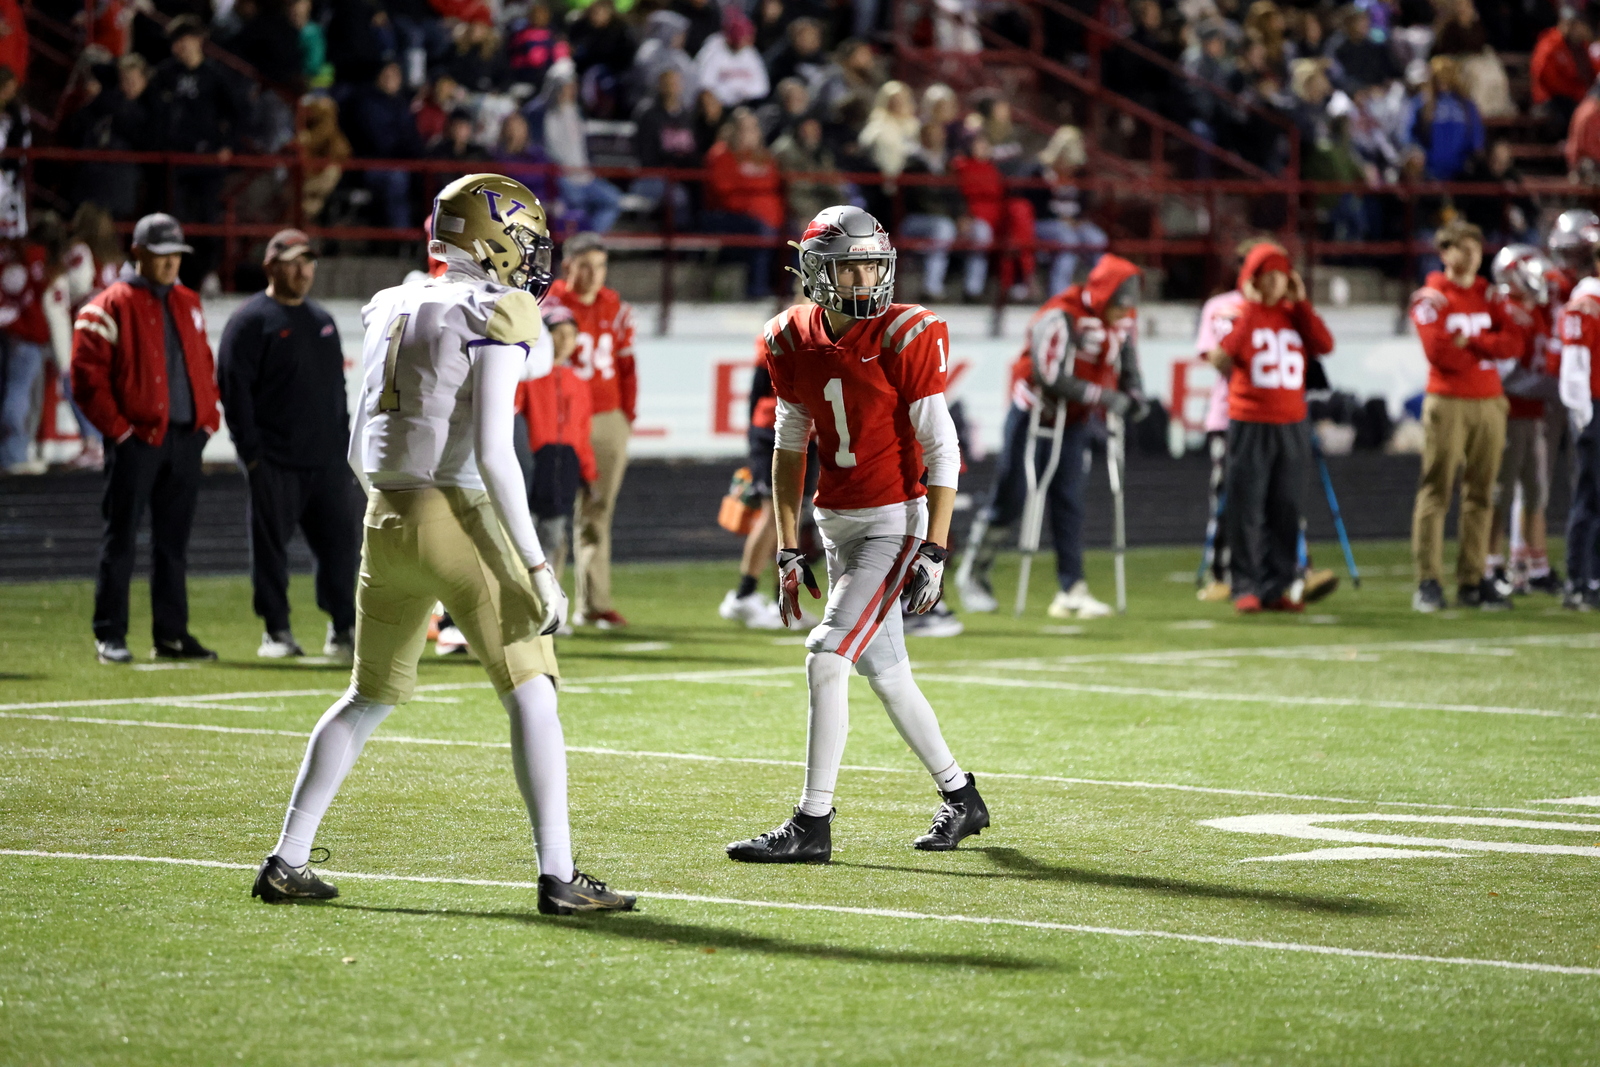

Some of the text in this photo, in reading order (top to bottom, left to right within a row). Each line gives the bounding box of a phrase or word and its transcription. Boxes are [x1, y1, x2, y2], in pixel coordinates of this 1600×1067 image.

[482, 189, 527, 223] V
[379, 313, 412, 412] 1
[573, 332, 616, 380] 34
[936, 338, 947, 373] 1
[1251, 327, 1305, 391] 26
[823, 377, 857, 468] 1
